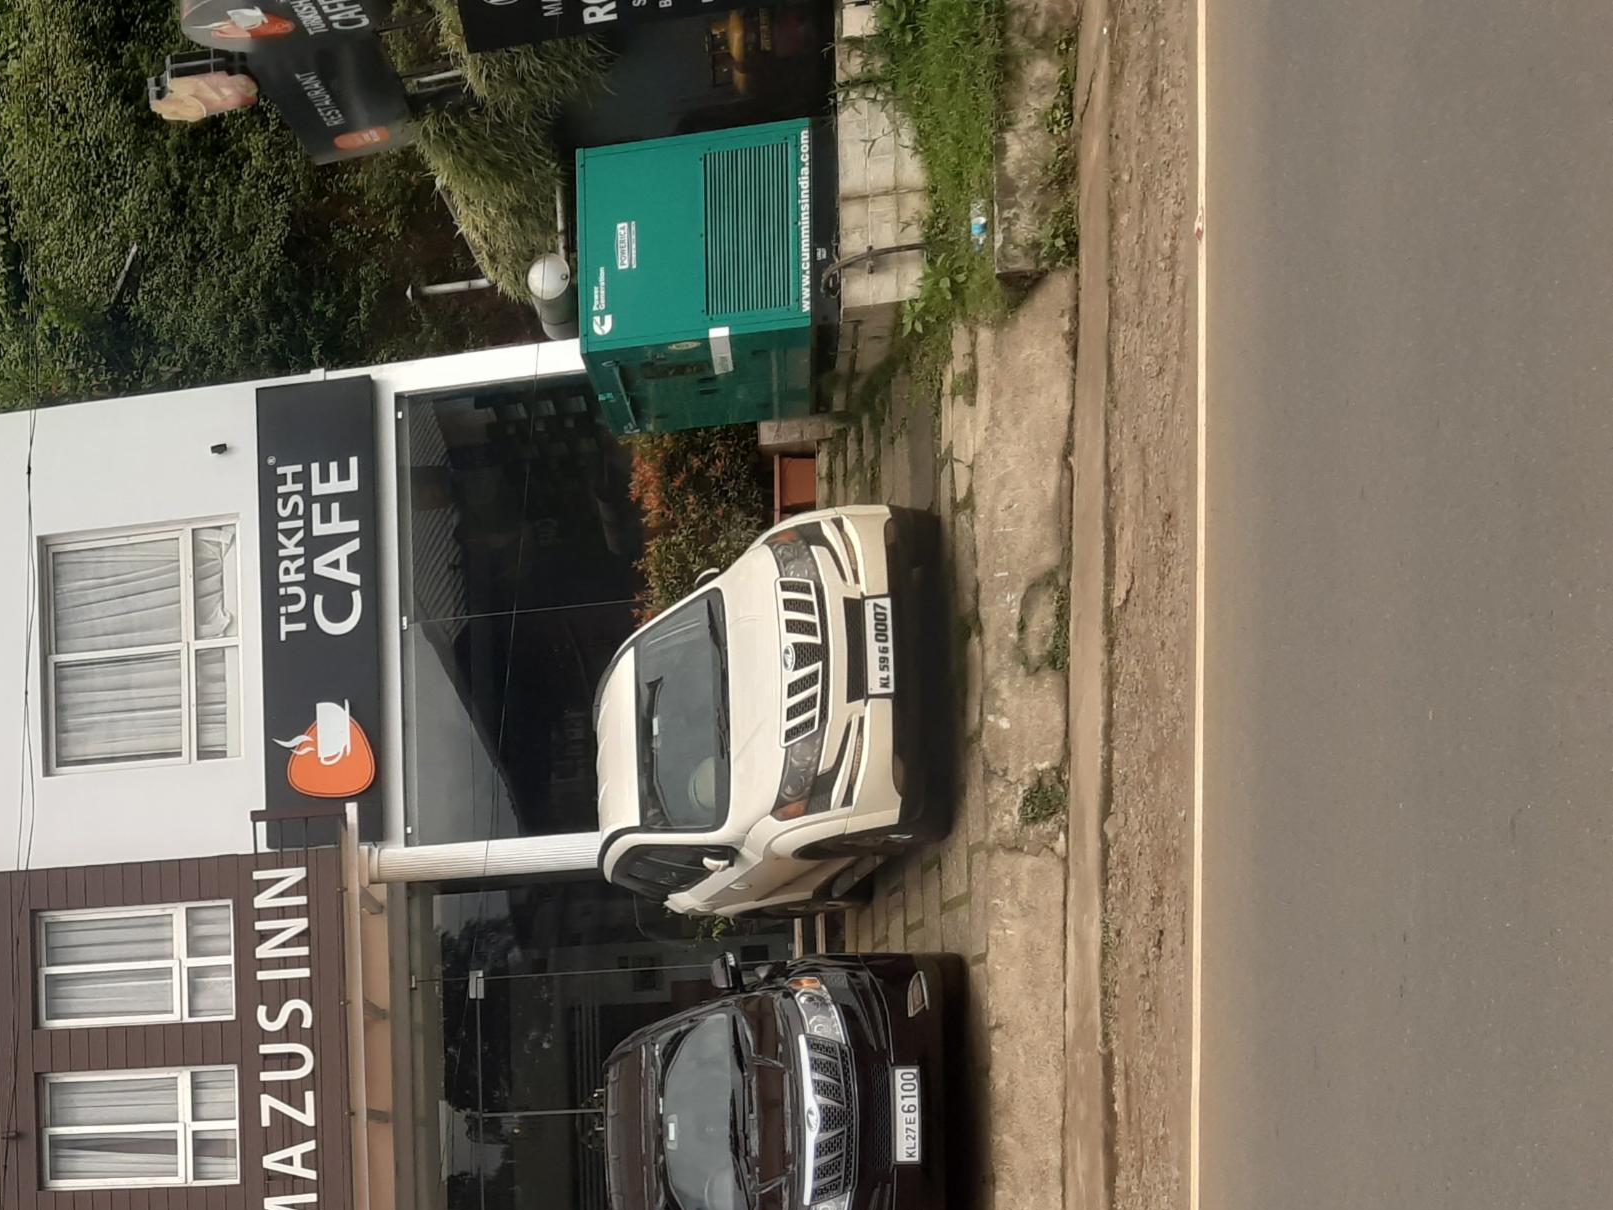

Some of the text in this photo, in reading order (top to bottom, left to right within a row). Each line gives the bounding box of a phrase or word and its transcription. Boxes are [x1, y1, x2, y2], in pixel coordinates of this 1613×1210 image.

[294, 71, 346, 127] RESTAURANT
[798, 129, 811, 312] www.cumminsindia.com
[619, 225, 627, 266] POWERICA
[598, 267, 606, 310] Generation
[311, 456, 362, 635] CAFE
[872, 601, 889, 643] 0007
[252, 866, 311, 982] INN
[900, 1071, 917, 1114] 6100
